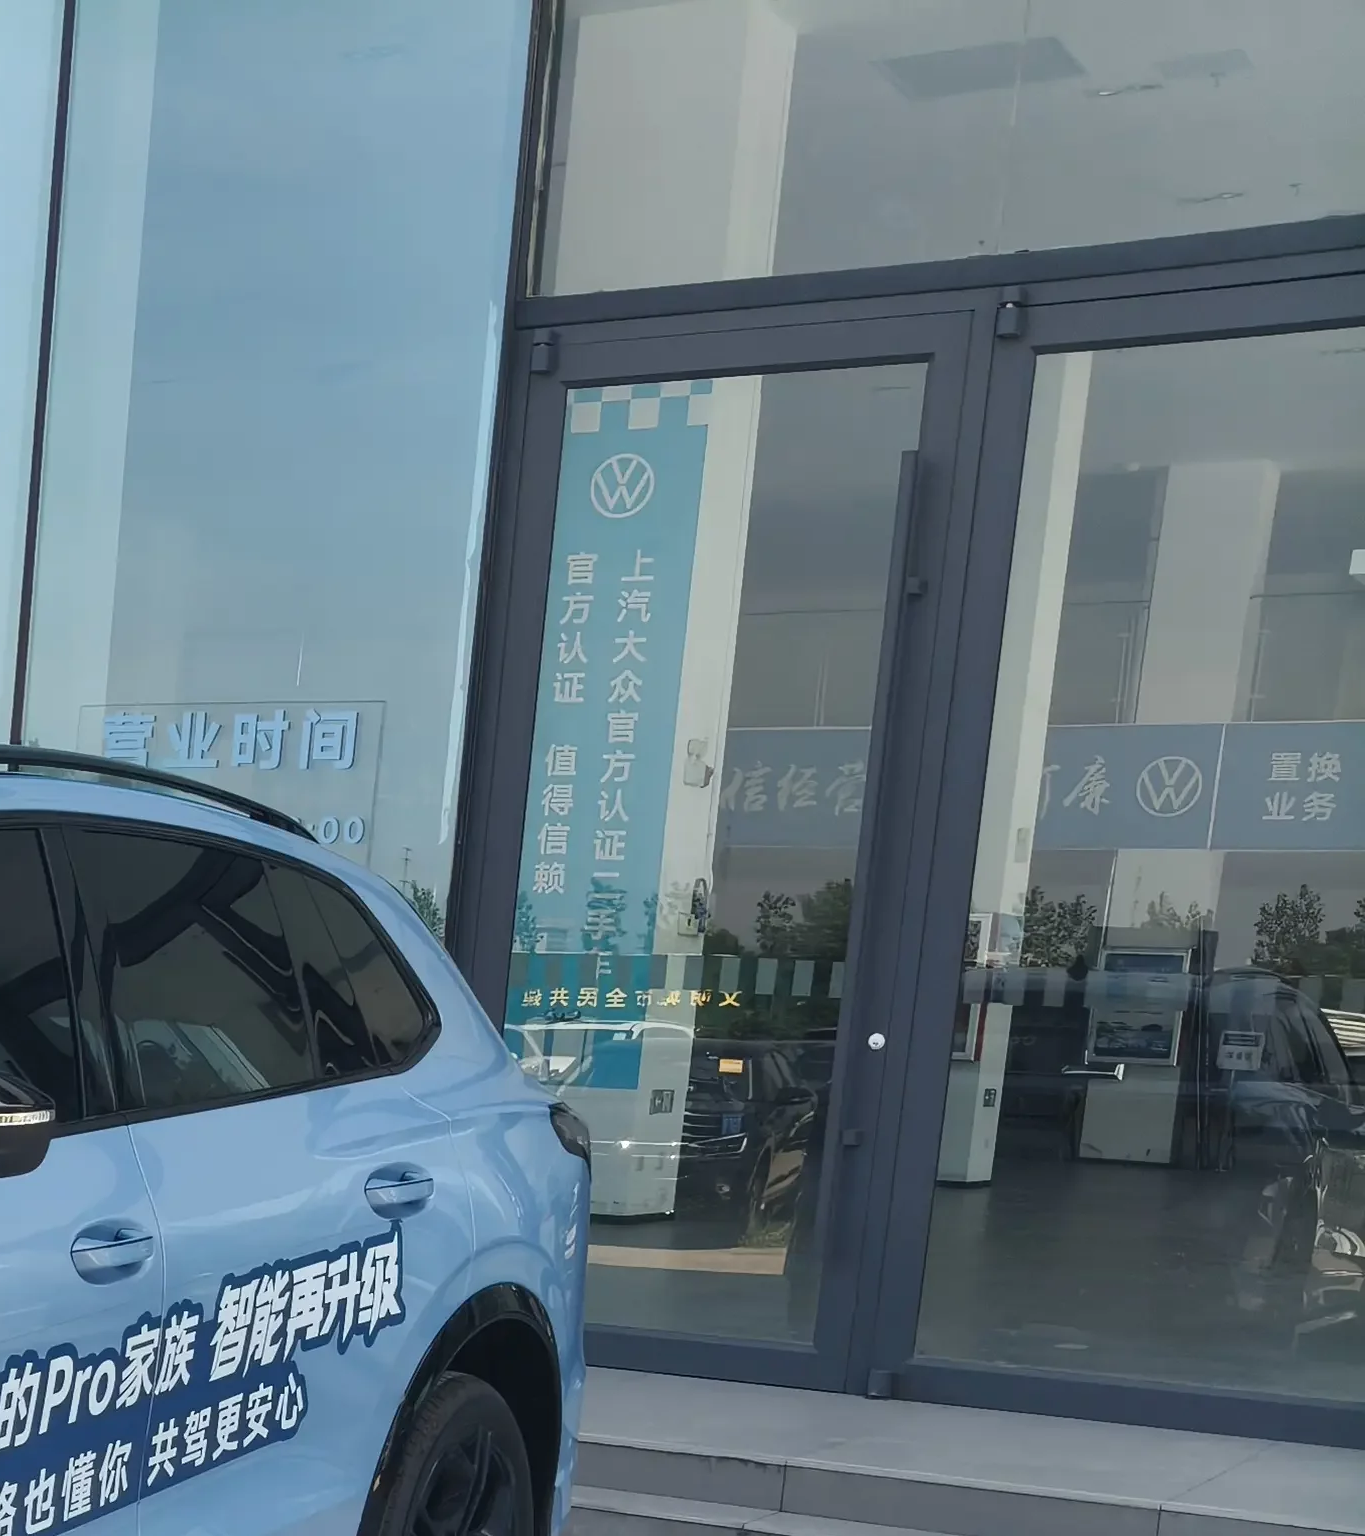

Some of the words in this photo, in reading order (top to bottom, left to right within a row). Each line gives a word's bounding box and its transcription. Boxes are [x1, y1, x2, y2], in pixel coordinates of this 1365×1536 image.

[553, 552, 598, 703] 官方认证
[104, 708, 360, 770] 营业时间
[1267, 752, 1342, 782] 置换
[533, 744, 578, 894] 值得信赖
[1262, 791, 1337, 821] 业务
[209, 1232, 403, 1382] 智能再升级
[146, 1372, 304, 1488] 共驾更安心
